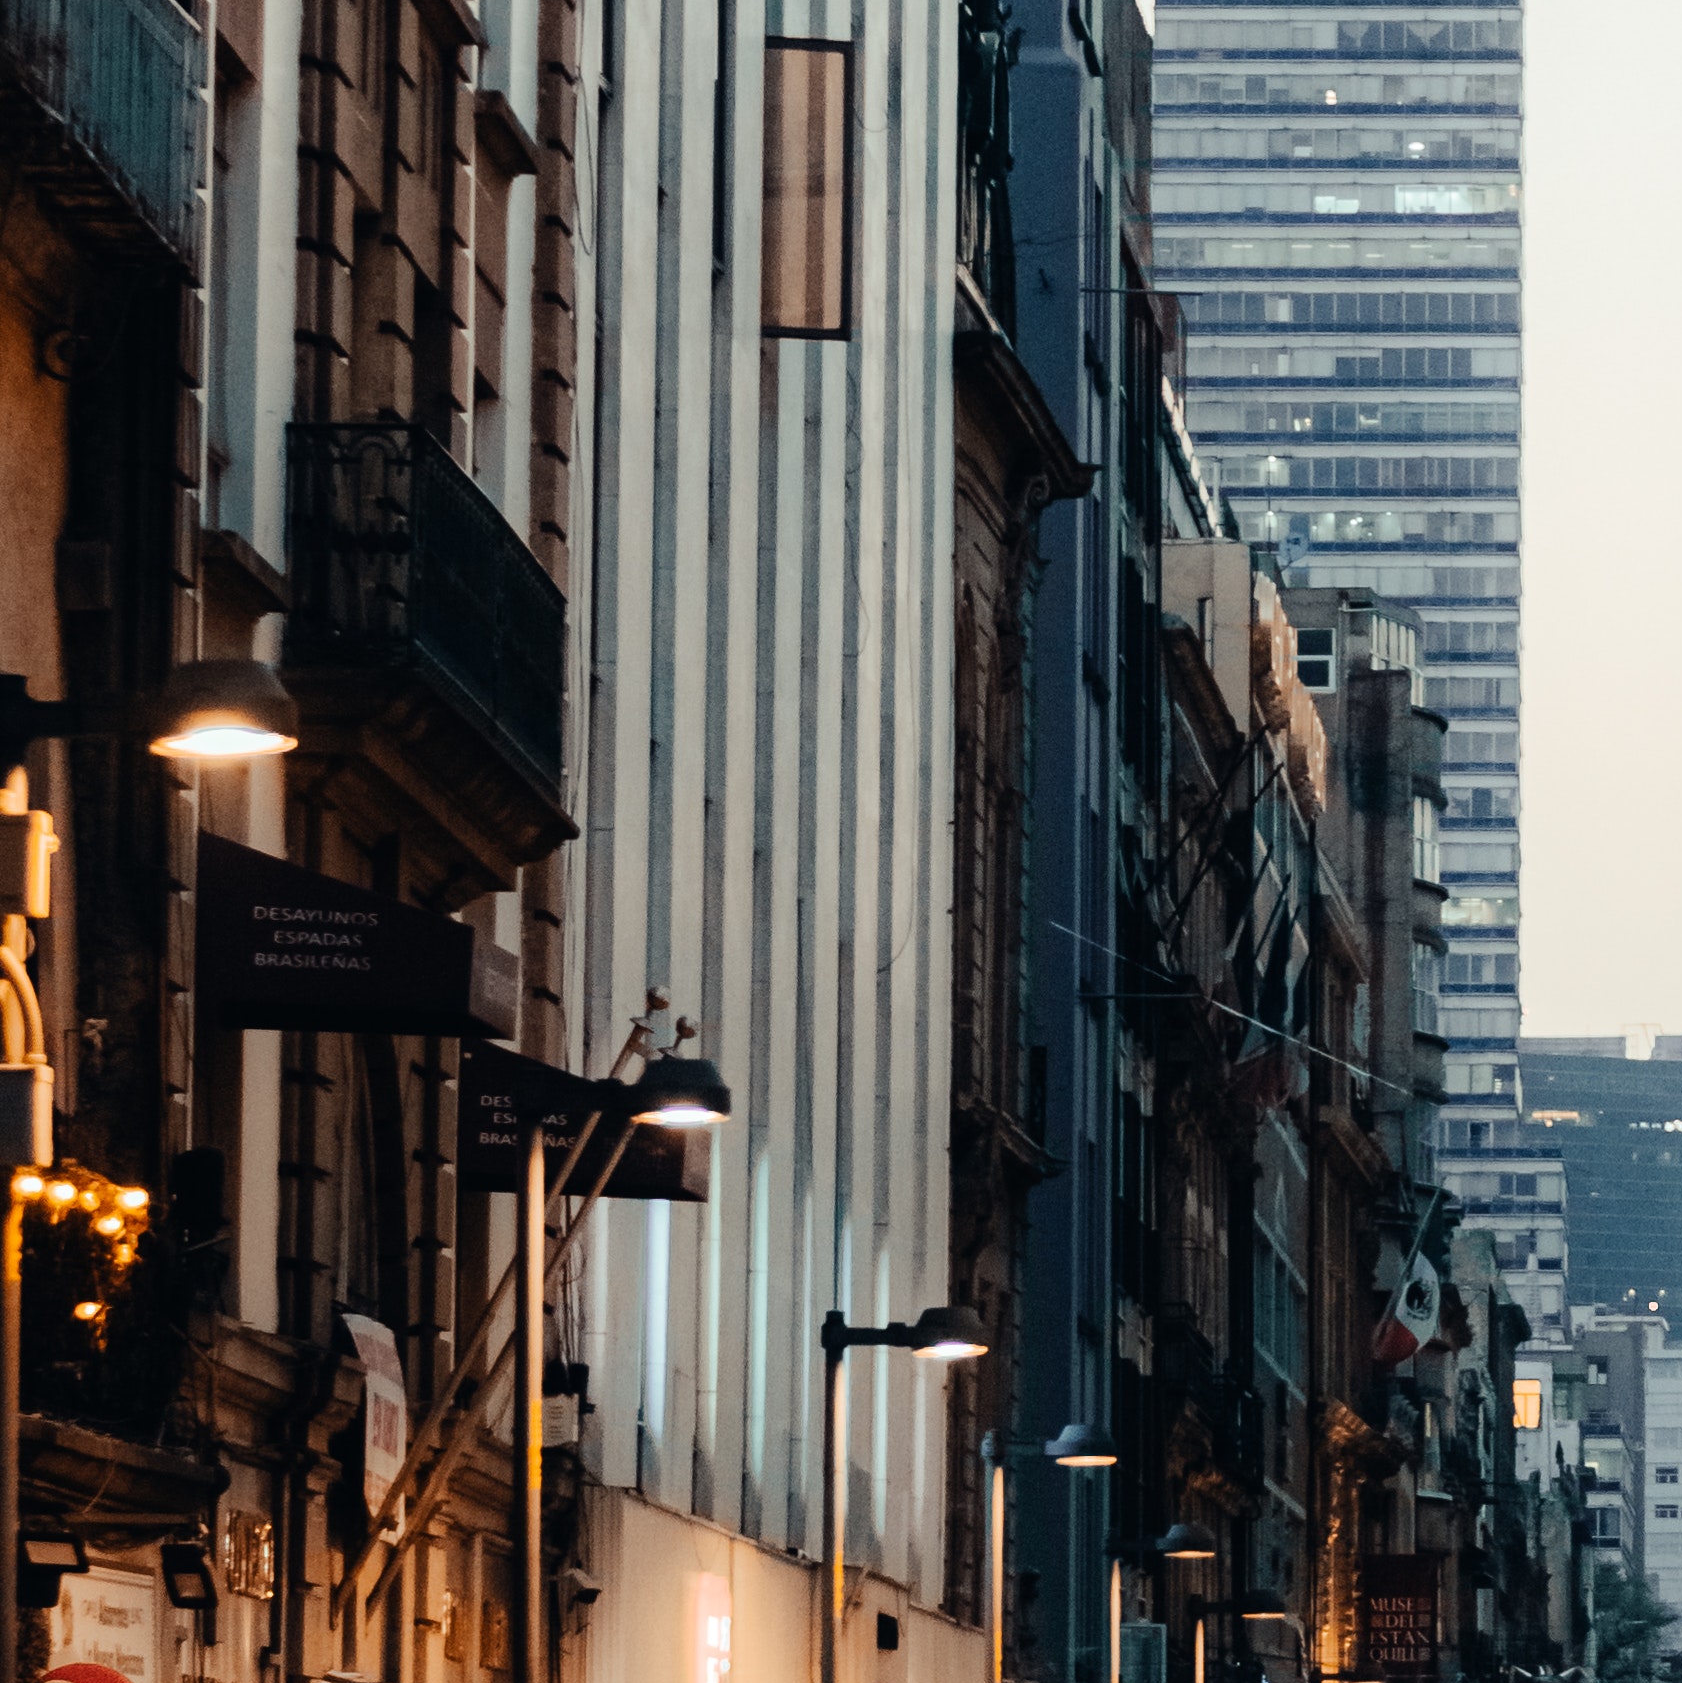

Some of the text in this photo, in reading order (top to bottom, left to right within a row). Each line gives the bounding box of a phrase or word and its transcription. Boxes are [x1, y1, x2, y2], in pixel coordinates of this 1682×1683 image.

[252, 905, 380, 927] DESAYUNOS
[273, 930, 364, 947] ESPADAS
[253, 951, 372, 971] BRASILEÑAS
[1384, 1613, 1415, 1628] DEL
[1370, 1631, 1430, 1645] ESTAN
